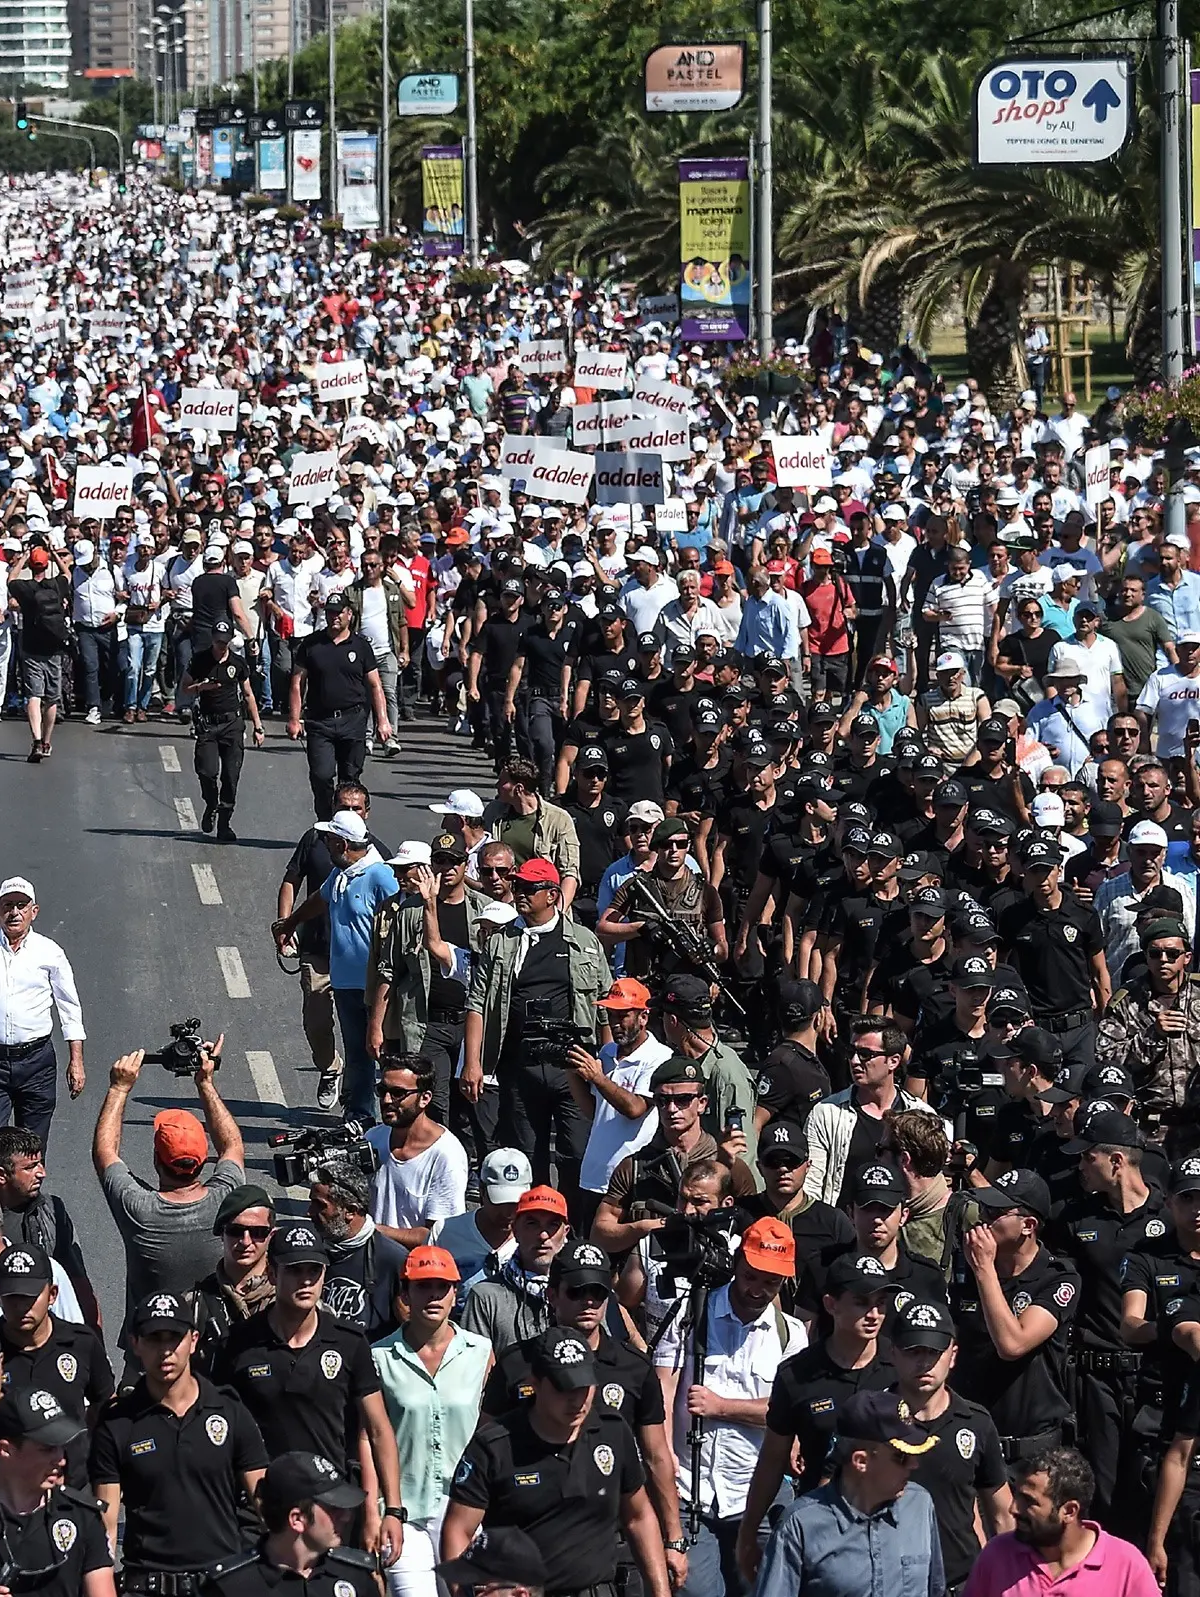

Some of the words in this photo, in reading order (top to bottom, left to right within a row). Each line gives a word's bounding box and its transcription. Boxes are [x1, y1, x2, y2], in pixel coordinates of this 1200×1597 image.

[667, 68, 722, 80] PASTEL
[416, 78, 440, 87] AND
[990, 69, 1077, 100] OTO
[411, 89, 444, 97] PASTEL
[992, 97, 1069, 125] shops
[1046, 121, 1057, 131] by
[687, 206, 743, 216] marmara
[521, 350, 563, 365] adalet
[578, 364, 623, 378] adalet
[321, 372, 363, 389] adalet
[636, 389, 686, 413] adalet
[184, 402, 235, 416] adalet
[629, 430, 686, 449] adalet
[779, 453, 825, 470] adalet
[292, 468, 333, 489] adalet
[532, 465, 589, 487] adalet
[598, 469, 660, 488] adalet
[79, 483, 129, 501] adalet
[657, 508, 686, 519] adalet
[1169, 690, 1199, 701] adal
[528, 1195, 557, 1204] BASIN
[760, 1242, 788, 1253] BASIN
[8, 1265, 30, 1273] POLİS
[418, 1259, 446, 1268] BASIN
[911, 1319, 936, 1327] POLİS
[560, 1354, 583, 1364] POLİS
